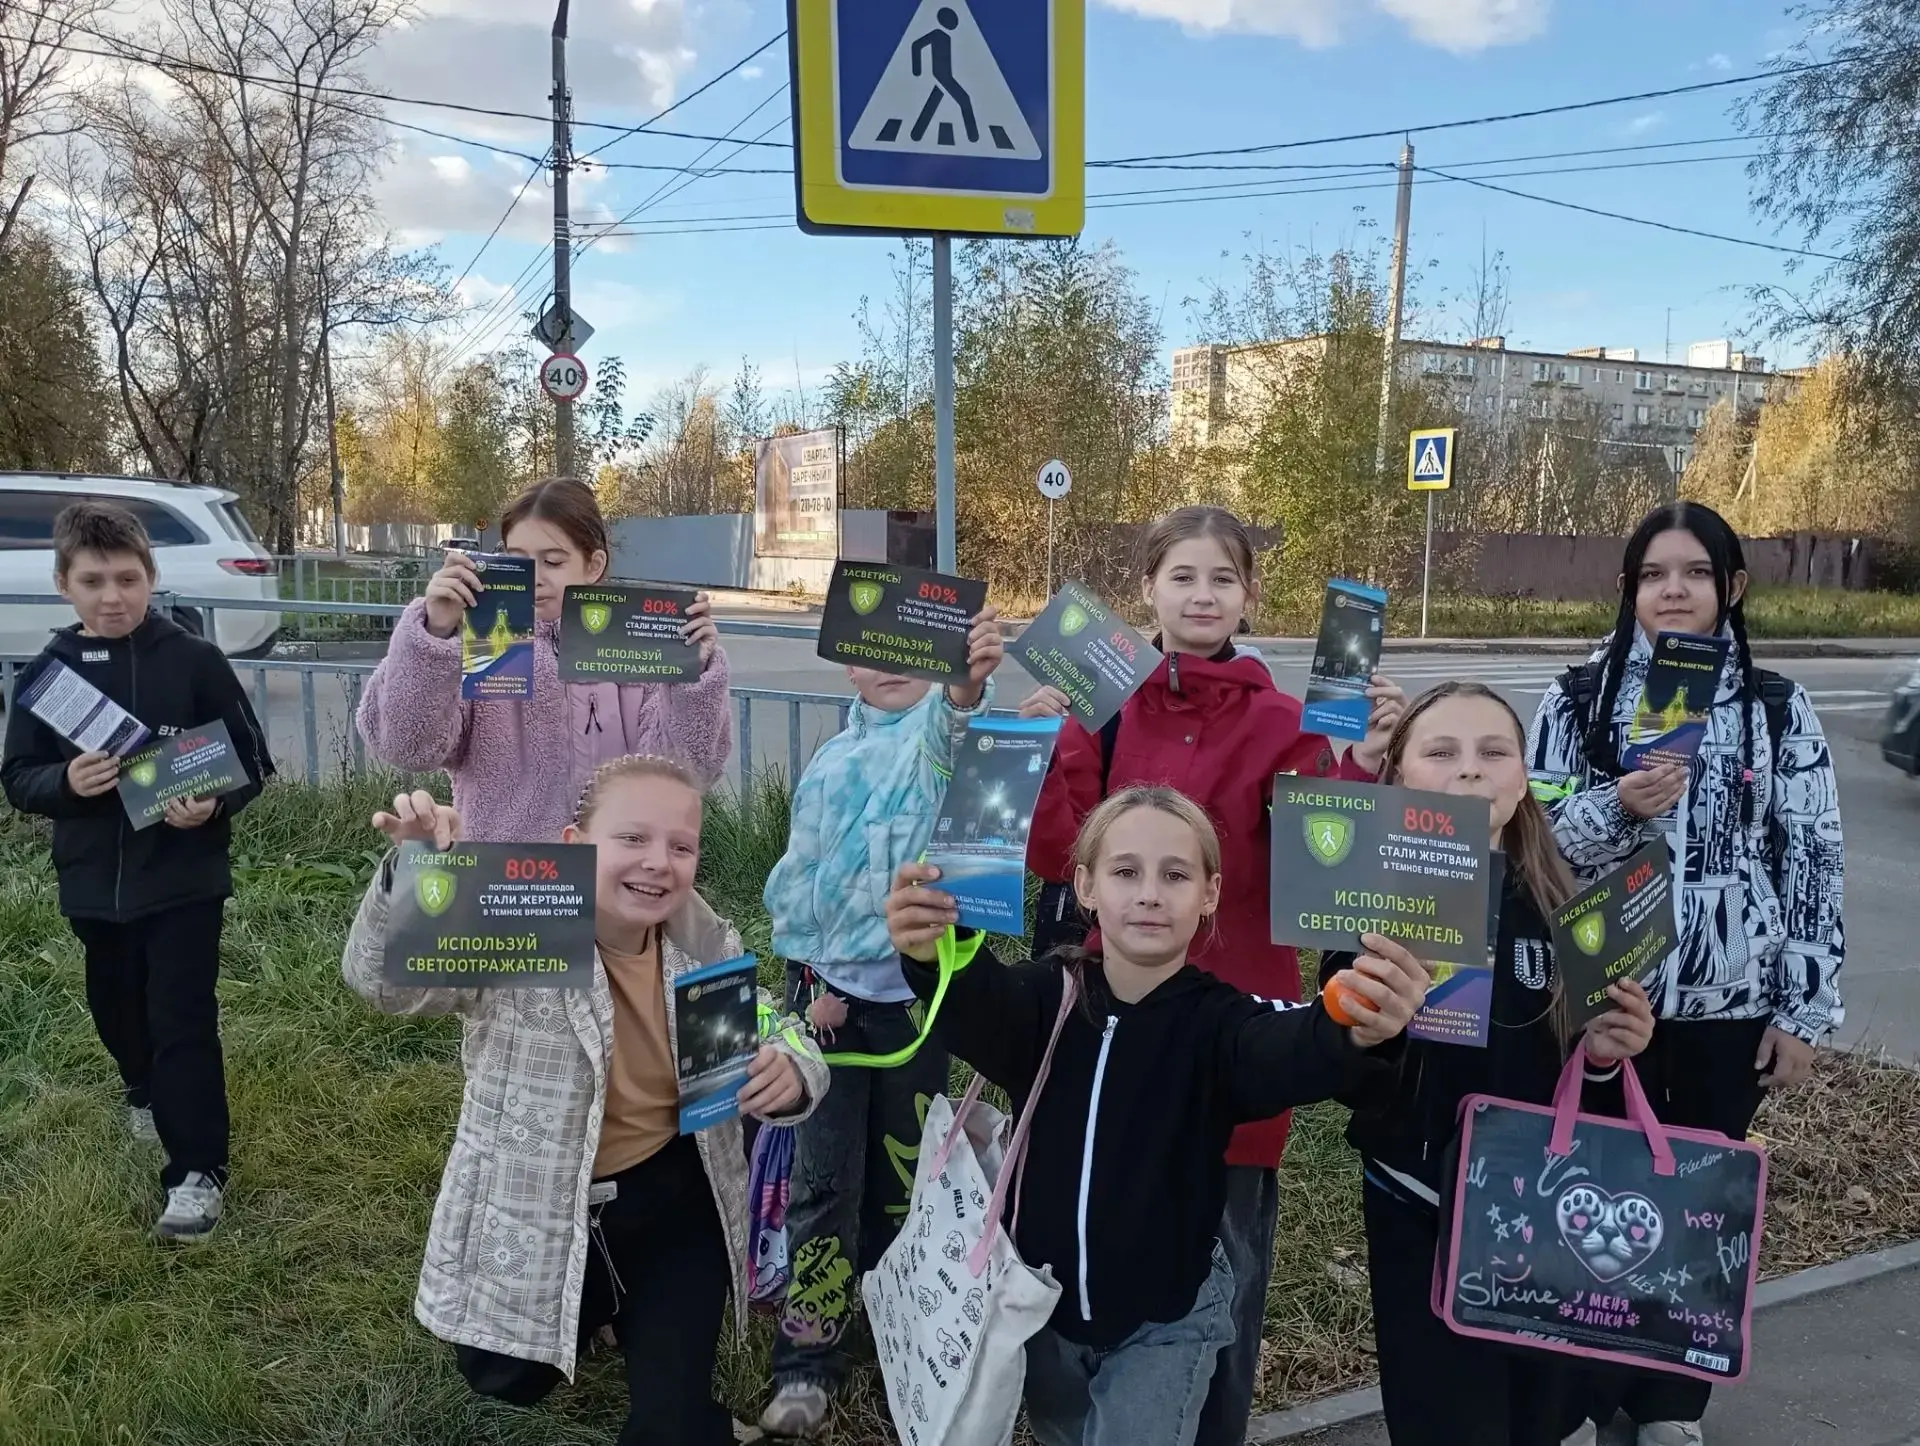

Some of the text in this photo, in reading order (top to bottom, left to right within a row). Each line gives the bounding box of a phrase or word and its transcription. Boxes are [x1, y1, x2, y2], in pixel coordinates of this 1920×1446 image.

[550, 368, 577, 386] 40
[1044, 472, 1065, 486] 40
[800, 497, 832, 513] 211-78-10
[842, 568, 902, 584] ЗАСВЕТИСЬ!
[918, 582, 957, 604] 80%
[643, 599, 678, 615] 80%
[897, 605, 924, 617] СТАЛИ
[1068, 586, 1107, 624] ЗАСВЕТИСЬ!
[626, 621, 682, 633] СТАЛИ ЖЕРТВА
[927, 621, 947, 630] ВРЕМЯ
[948, 624, 967, 634] СУТОК
[861, 630, 934, 653] ИСПОЛЬЗУЙ
[1110, 631, 1139, 663] 80%
[597, 648, 662, 661] ИСПОЛЬЗУЙ
[835, 642, 952, 673] СВЕТООТРАЖАТЕЛЬ
[1087, 641, 1134, 686] СТАЛИ ЖЕРТВАМИ
[575, 661, 683, 675] СВЕТООТРАЖАТЕЛЬ
[1049, 647, 1096, 693] ИСПОЛЬЗУЙ
[1658, 659, 1714, 672] СТАНЬ ЗАМЕТНЕЙ
[1025, 647, 1095, 717] СВЕТООТРАЖАТЕЛЬ
[177, 735, 210, 753] 80%
[156, 769, 211, 799] ИСПОЛЬЗУЙ
[1287, 791, 1376, 812] ЗАСВЕТИСЬ!
[1404, 807, 1456, 836] 80%
[1387, 833, 1471, 853] ПОГИБШИХ ПЕШЕХОДОВ
[1378, 845, 1478, 869] СТАЛИ ЖЕРТВАМИ
[505, 858, 560, 880] 80%
[1383, 861, 1475, 881] В ТЕМНОЕ ВРЕМЯ СУТОК
[1626, 861, 1654, 893] 80%
[488, 884, 575, 892] ПОГИБШИХ ПЕШЕХОДОВ
[479, 894, 583, 905] СТАЛИ ЖЕРТВАМИ
[1335, 889, 1436, 917] ИСПОЛЬЗУЙ
[1558, 886, 1612, 927] ЗАСВЕТИСЬ!
[1620, 878, 1668, 925] СТАЛИ ЖЕРТВАМИ
[483, 908, 579, 916] В ТЕМНОЕ ВРЕМЯ СУТОК
[1298, 912, 1464, 945] СВЕТООТРАЖАТЕЛЬ
[437, 933, 538, 951] ИСПОЛЬЗУЙ
[1605, 927, 1655, 979] ИСПОЛЬЗУЙ
[406, 957, 569, 973] СВЕТООТРАЖАТЕЛЬ
[1413, 1014, 1472, 1028] безопасности
[1423, 1005, 1480, 1021] Позаботьтесь
[1415, 1023, 1450, 1034] начните
[1457, 1028, 1480, 1038] себя!
[953, 1188, 965, 1219] HELLO
[1684, 1209, 1725, 1231] hey
[937, 1267, 957, 1295] HELLO
[1458, 1271, 1560, 1307] Shine
[792, 1299, 817, 1316] TO
[1589, 1292, 1629, 1313] МЕНЯ
[1573, 1306, 1623, 1329] ЛАПКИ
[1668, 1308, 1734, 1332] what's
[959, 1331, 973, 1351] HEL
[1693, 1331, 1718, 1348] up
[926, 1356, 946, 1389] HELLO
[909, 1425, 920, 1446] HEL
